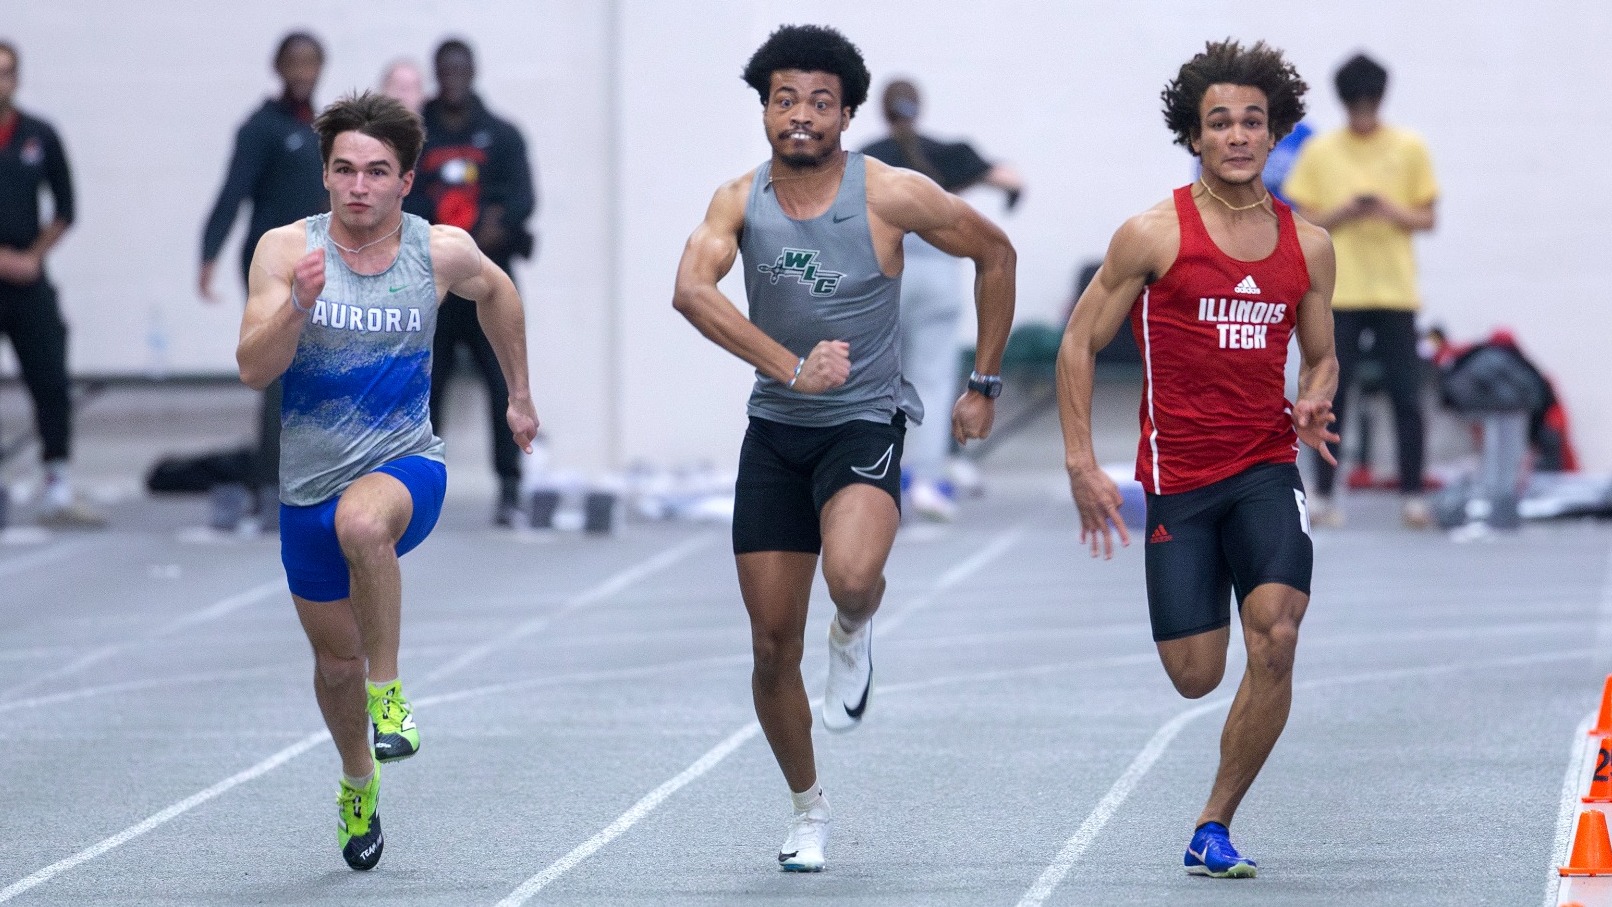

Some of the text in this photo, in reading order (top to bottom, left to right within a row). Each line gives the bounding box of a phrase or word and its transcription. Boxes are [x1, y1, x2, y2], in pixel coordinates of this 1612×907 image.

[782, 248, 840, 296] WLC
[311, 299, 421, 332] AURORA
[1198, 297, 1287, 324] ILLINOIS
[1216, 323, 1268, 349] TECH
[1592, 748, 1612, 781] 2
